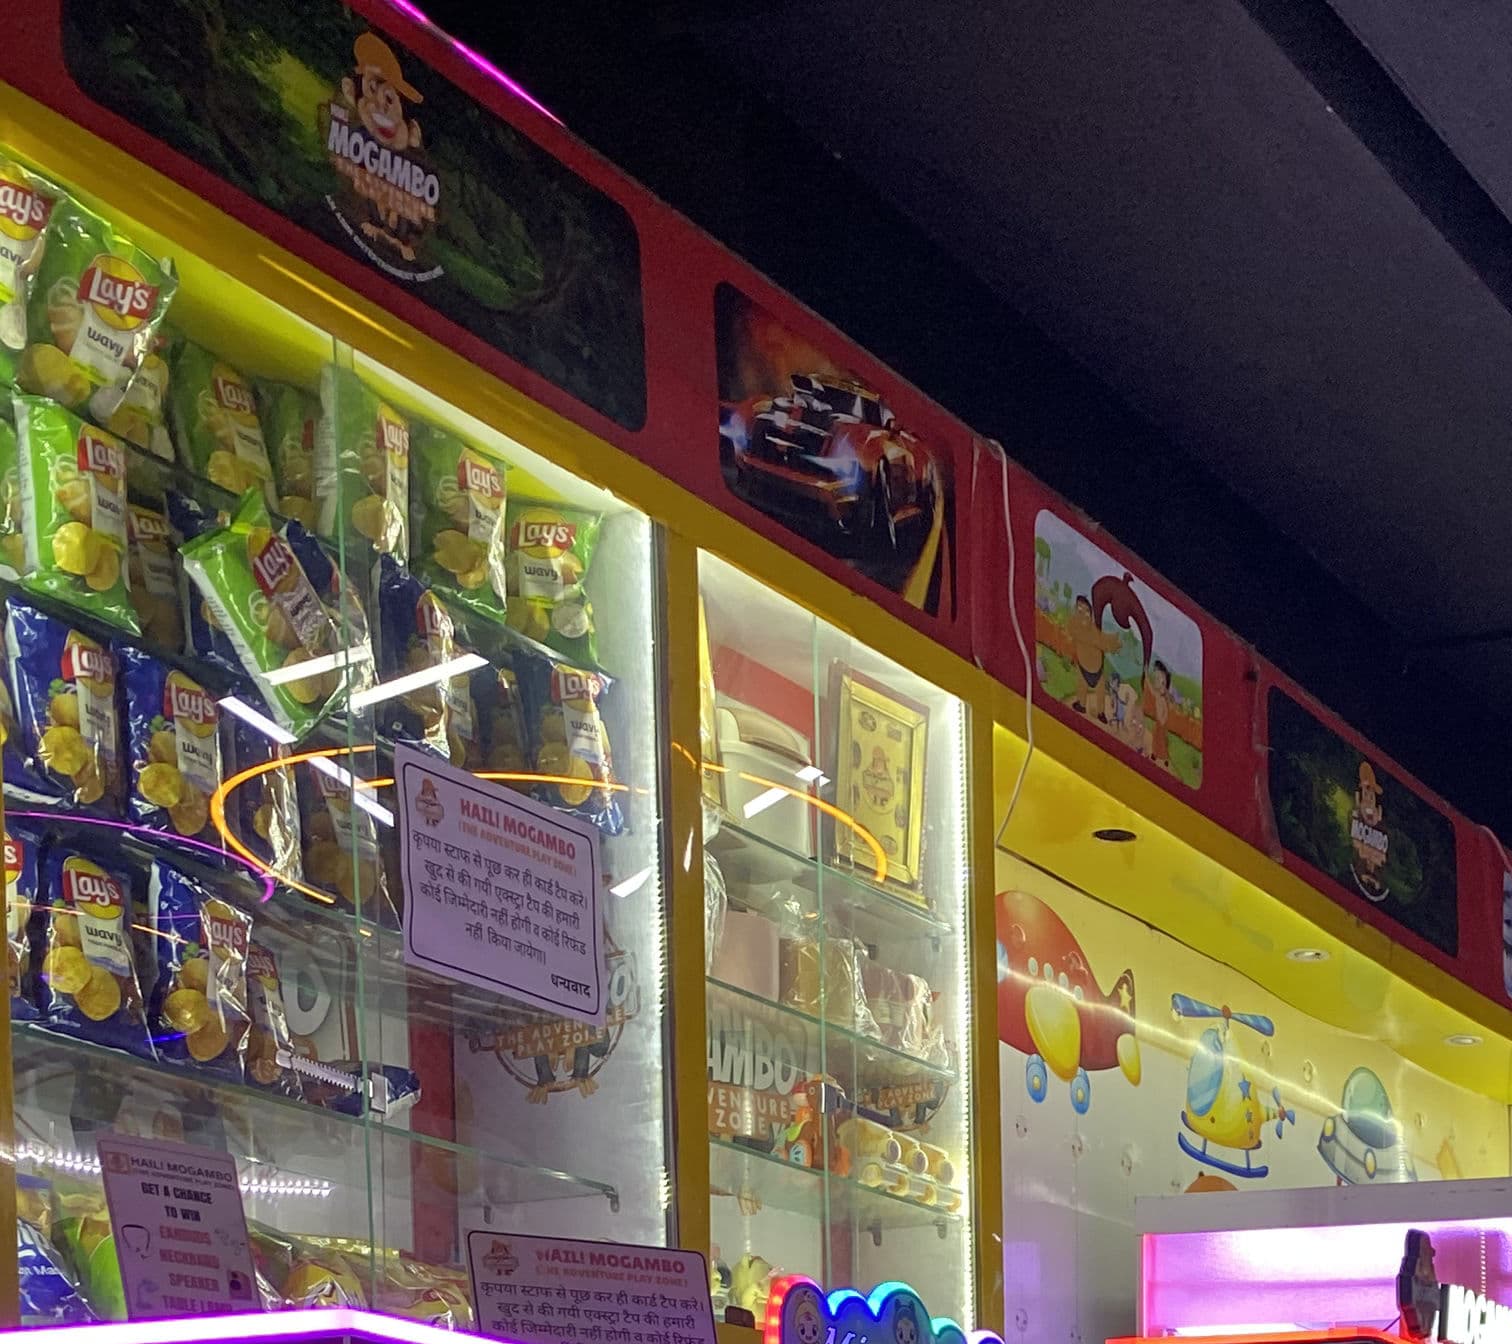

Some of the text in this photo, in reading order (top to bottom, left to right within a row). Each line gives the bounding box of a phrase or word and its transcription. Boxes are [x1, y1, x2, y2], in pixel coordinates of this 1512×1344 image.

[328, 119, 440, 206] MOGAMBO
[88, 267, 150, 316] Lay's
[87, 326, 125, 358] wavy
[518, 519, 571, 549] Lay's
[524, 564, 559, 582] wavy
[503, 815, 576, 860] MOGAMBO
[71, 869, 121, 906] Lay's
[85, 924, 124, 947] wavy
[551, 973, 591, 998] धन्यवाद
[167, 1163, 234, 1182] MOGAMBO
[141, 1182, 213, 1205] GET A CHANCE
[165, 1205, 178, 1218] TO
[590, 1252, 685, 1274] MOGAMBO
